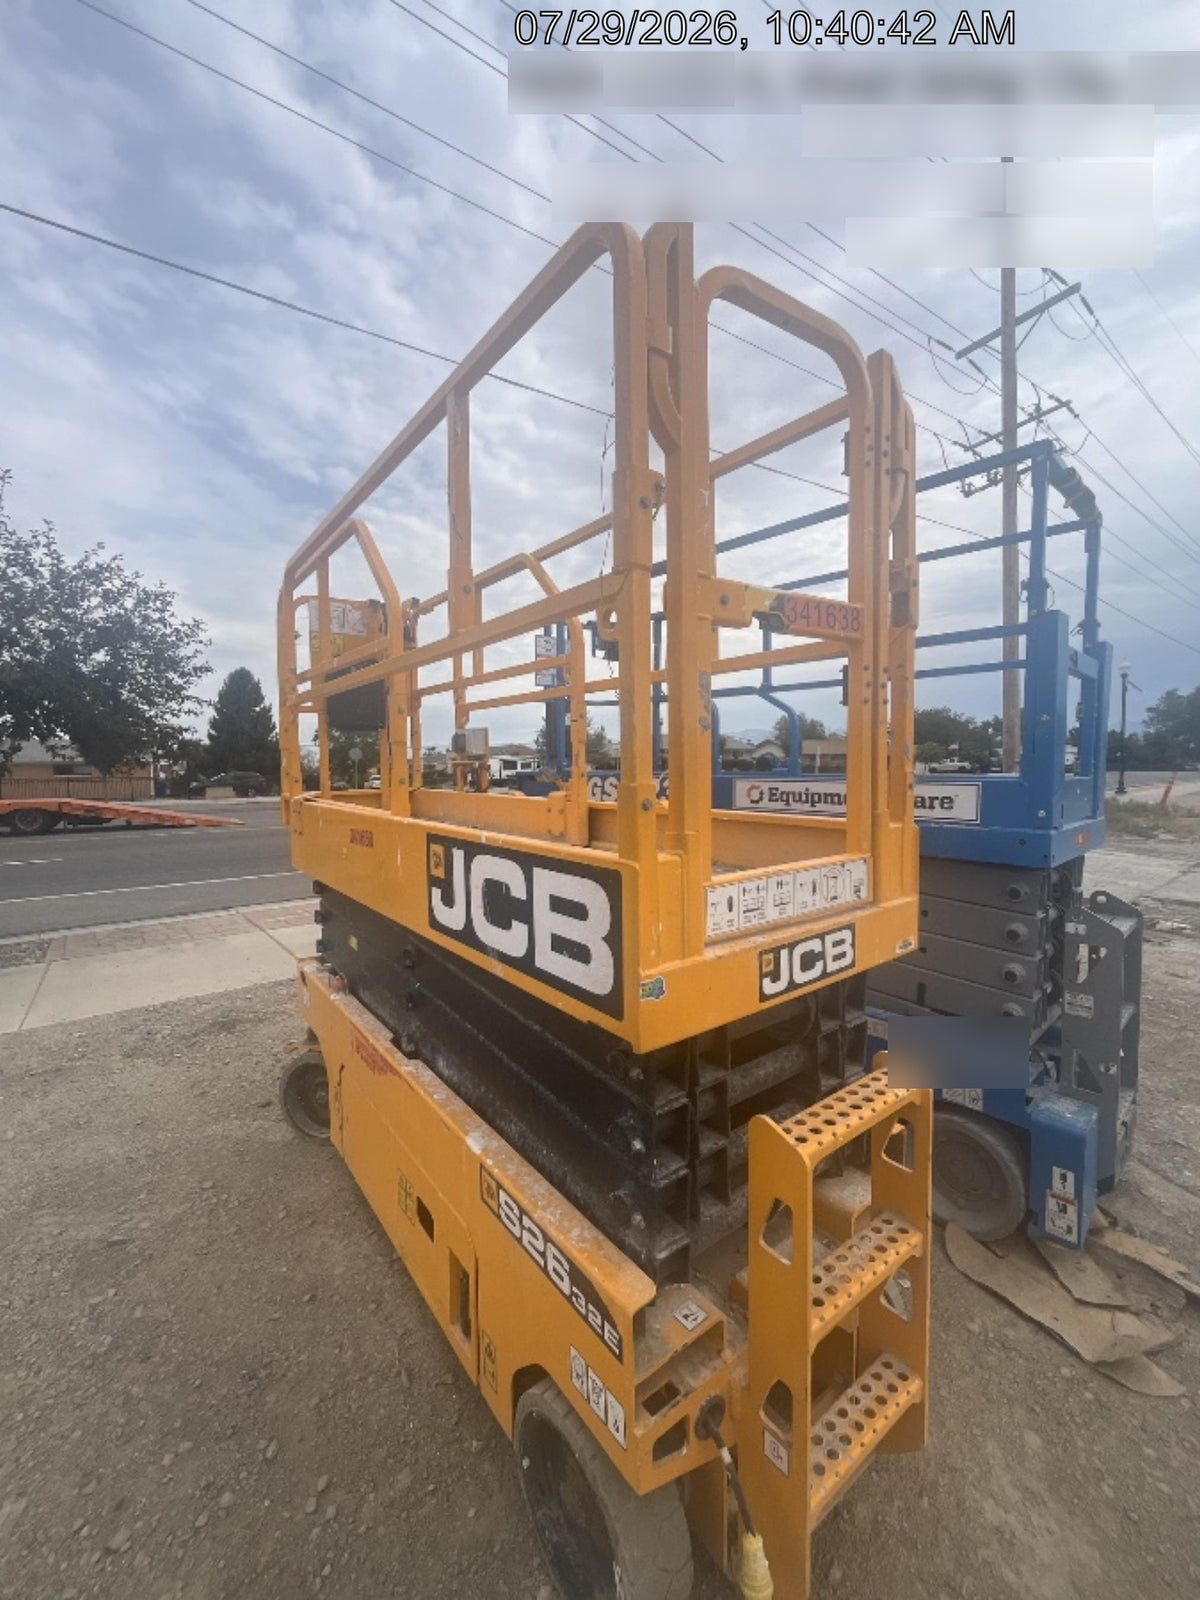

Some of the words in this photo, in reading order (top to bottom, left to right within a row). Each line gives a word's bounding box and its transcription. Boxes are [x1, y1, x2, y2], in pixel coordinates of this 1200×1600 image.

[784, 597, 861, 632] 341638
[431, 847, 614, 996] JCB
[762, 929, 853, 996] JCB
